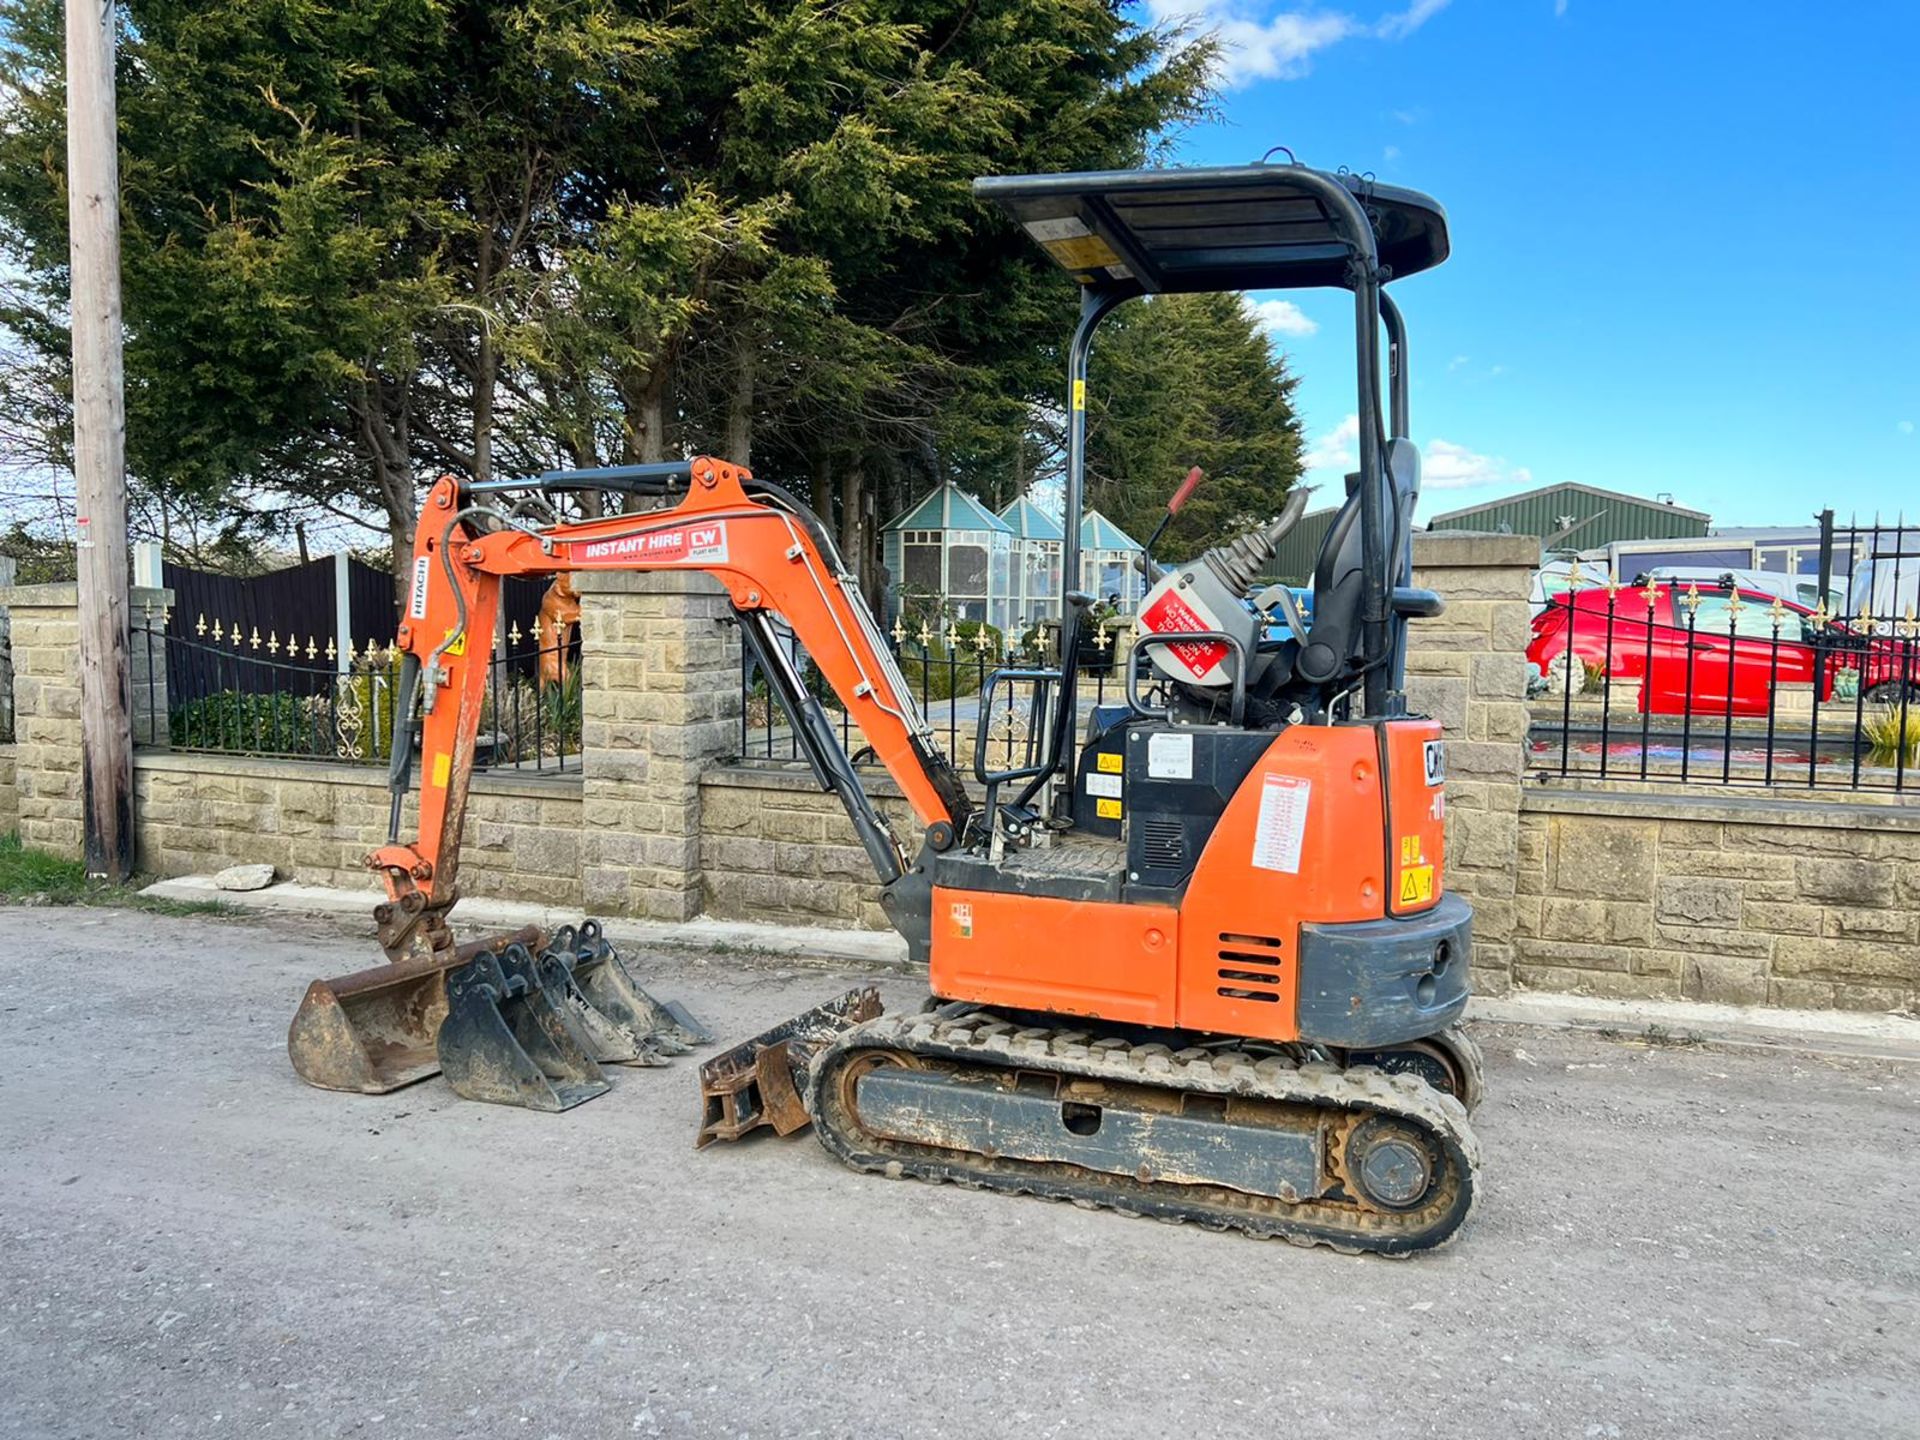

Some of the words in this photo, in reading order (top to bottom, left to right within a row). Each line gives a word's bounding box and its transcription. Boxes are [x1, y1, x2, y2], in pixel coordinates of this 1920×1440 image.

[586, 537, 646, 558] INSTANT
[648, 532, 683, 550] HIRE
[691, 529, 716, 547] CW
[414, 559, 426, 615] HITACHI
[1163, 604, 1177, 619] NO
[1163, 616, 1175, 630] TO
[1187, 642, 1201, 656] ON
